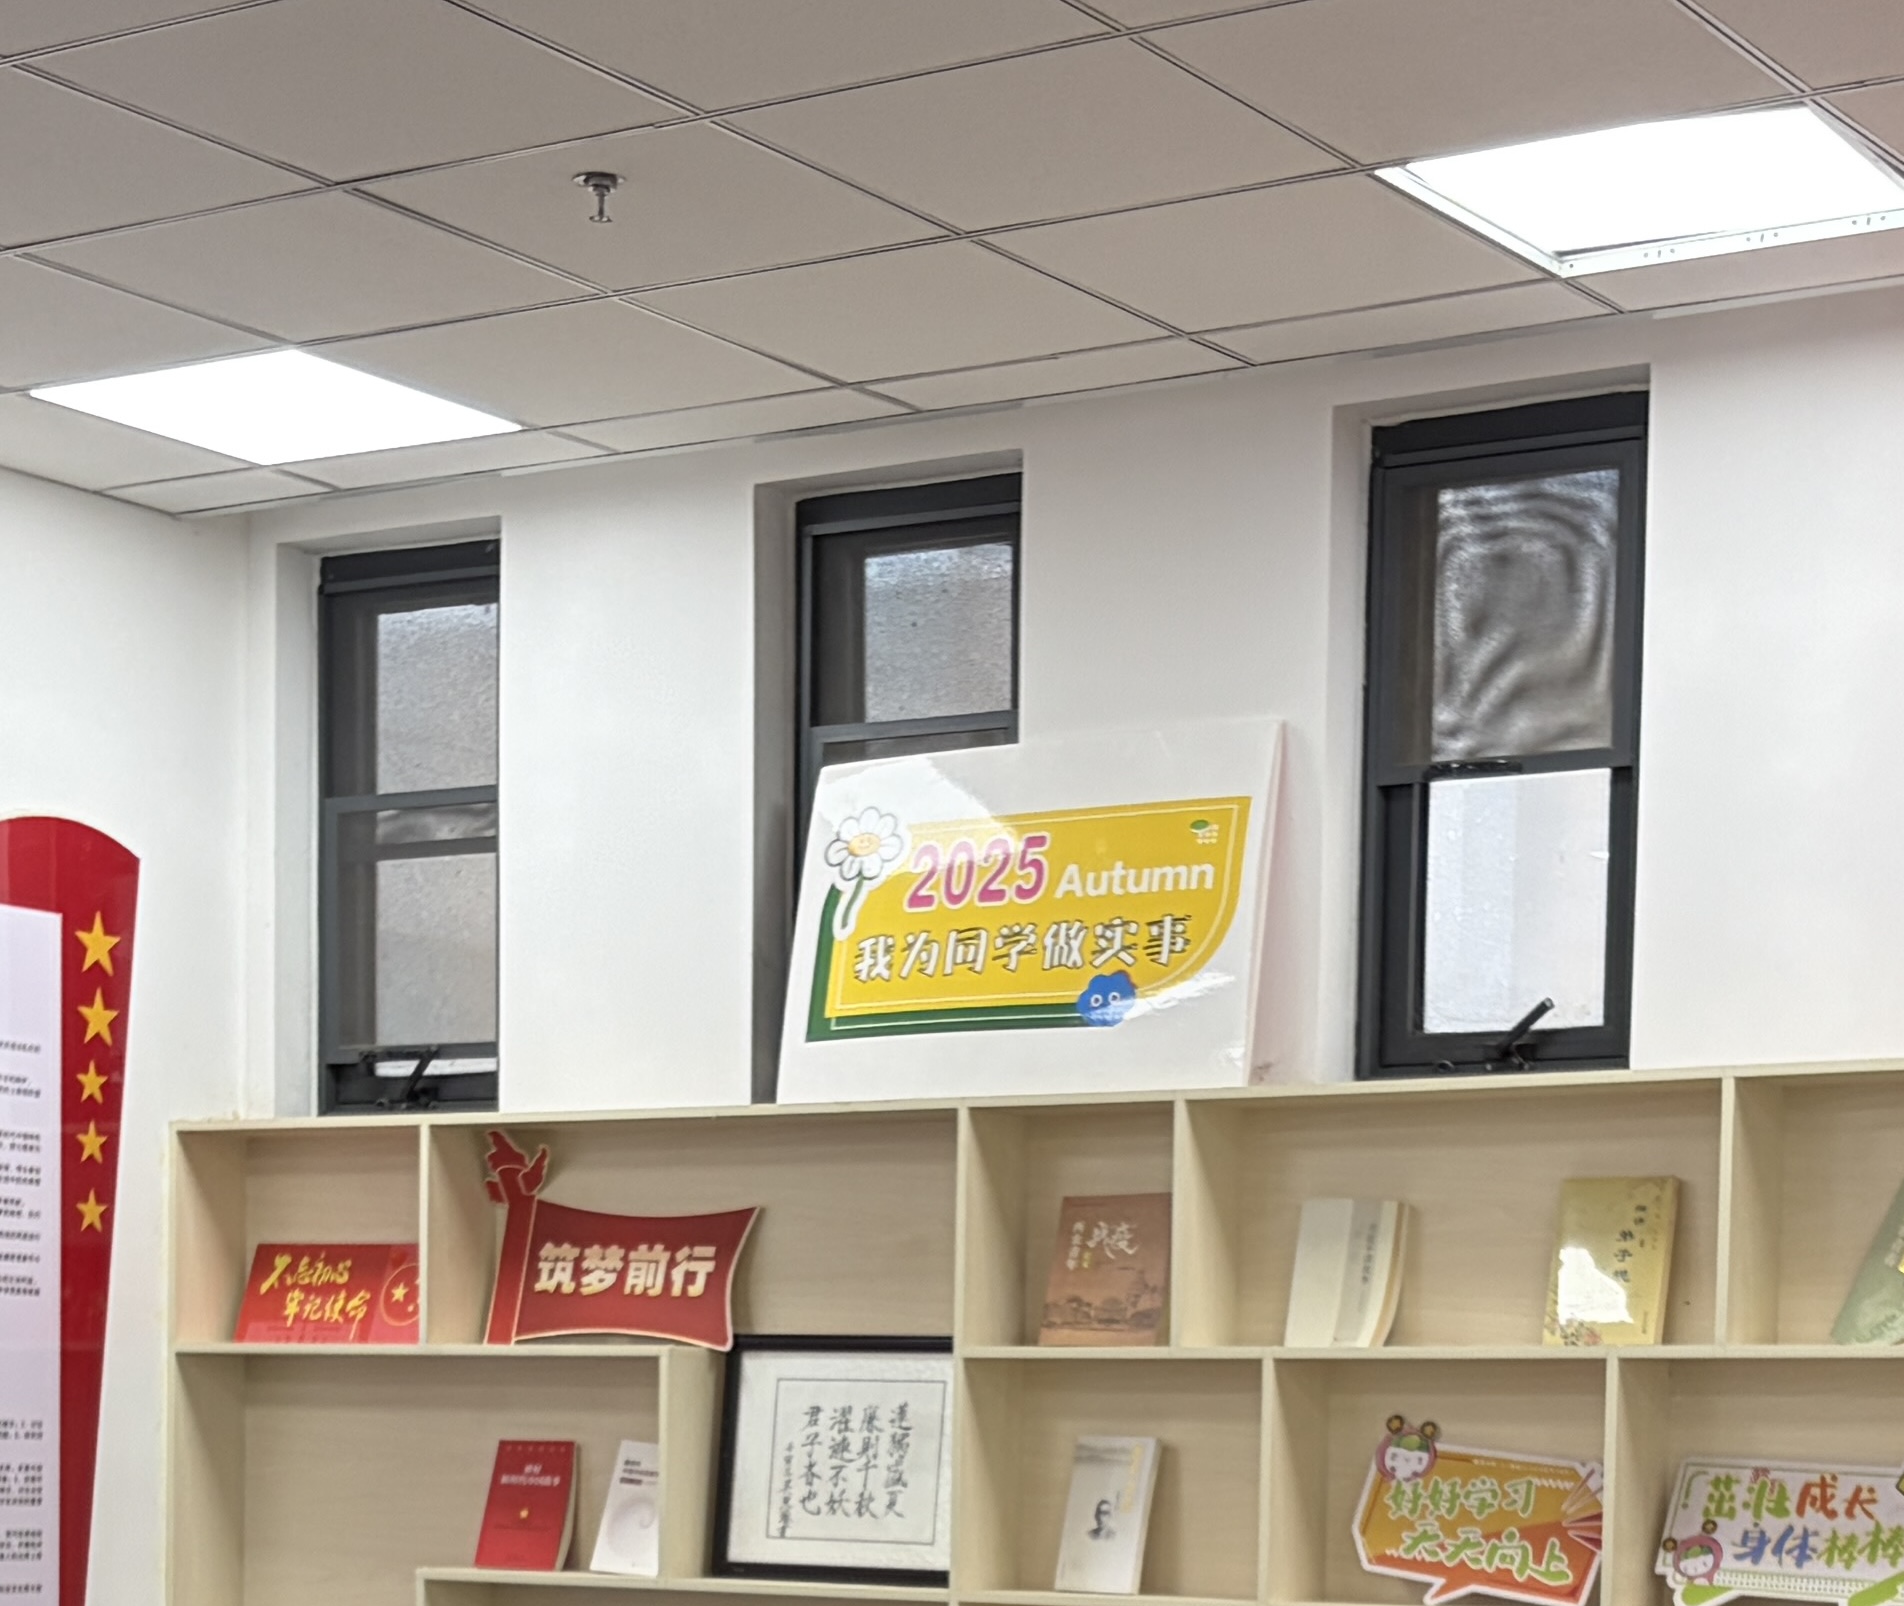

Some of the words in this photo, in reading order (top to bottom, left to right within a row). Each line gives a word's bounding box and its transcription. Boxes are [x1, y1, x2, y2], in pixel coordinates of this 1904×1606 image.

[905, 834, 1049, 912] 2025
[1054, 860, 1215, 899] Autumn
[853, 914, 1191, 983] 我为同学做实事
[260, 1252, 352, 1294] 不忘初心
[534, 1242, 717, 1297] 筑梦前行
[283, 1287, 372, 1341] 牢记使命
[1384, 1476, 1537, 1520] 好好学习
[1702, 1473, 1879, 1521] 茁壮成长
[1401, 1520, 1573, 1586] 天天向上
